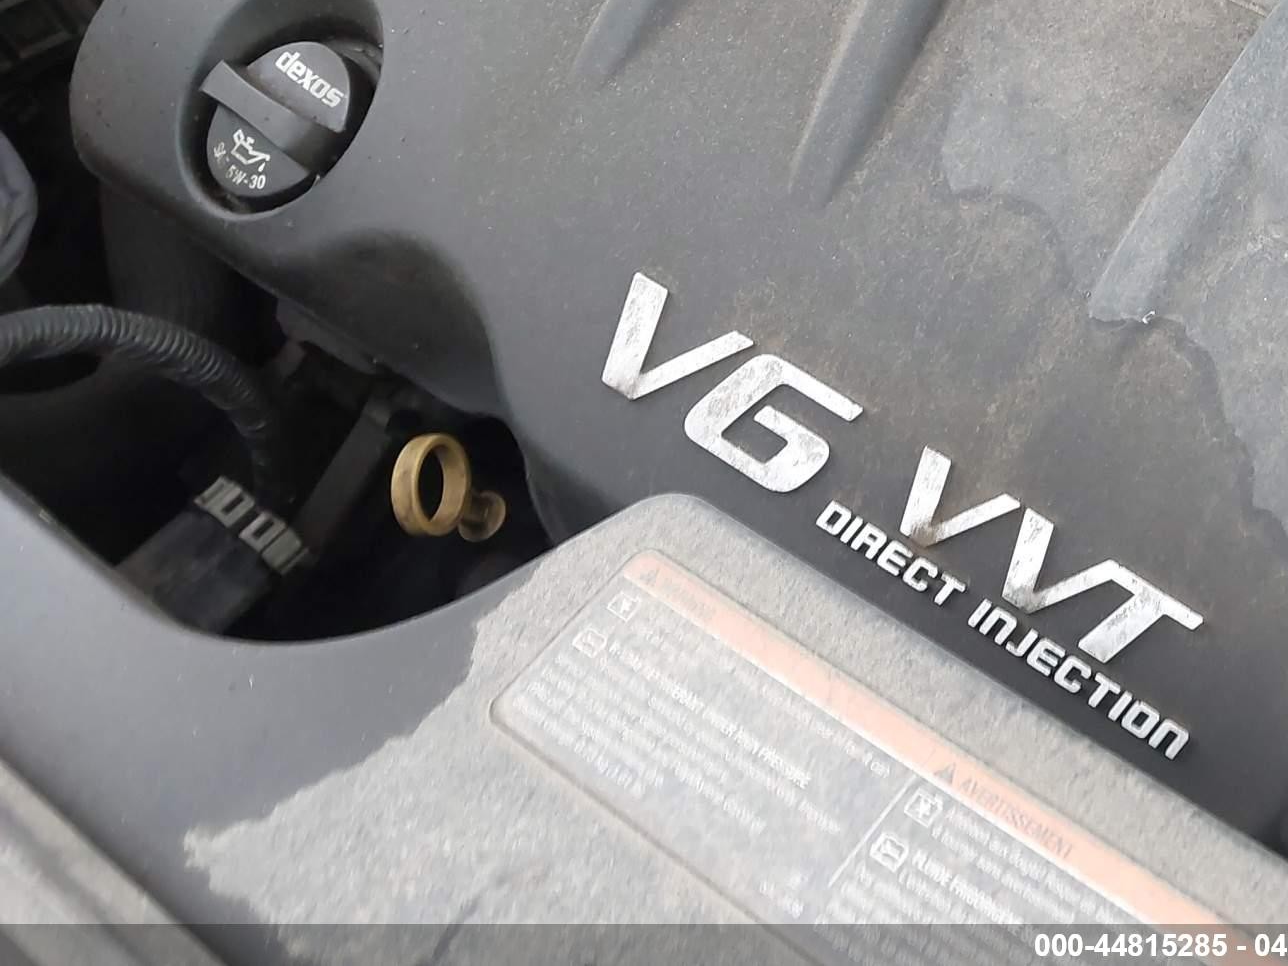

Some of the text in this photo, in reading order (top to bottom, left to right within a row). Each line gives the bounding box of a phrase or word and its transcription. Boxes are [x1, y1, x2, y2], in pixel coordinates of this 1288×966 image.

[275, 51, 345, 108] dexos
[601, 272, 864, 493] V6
[815, 500, 967, 606] DIRECT
[967, 598, 1189, 760] INJECTION
[900, 445, 1204, 664] VVT
